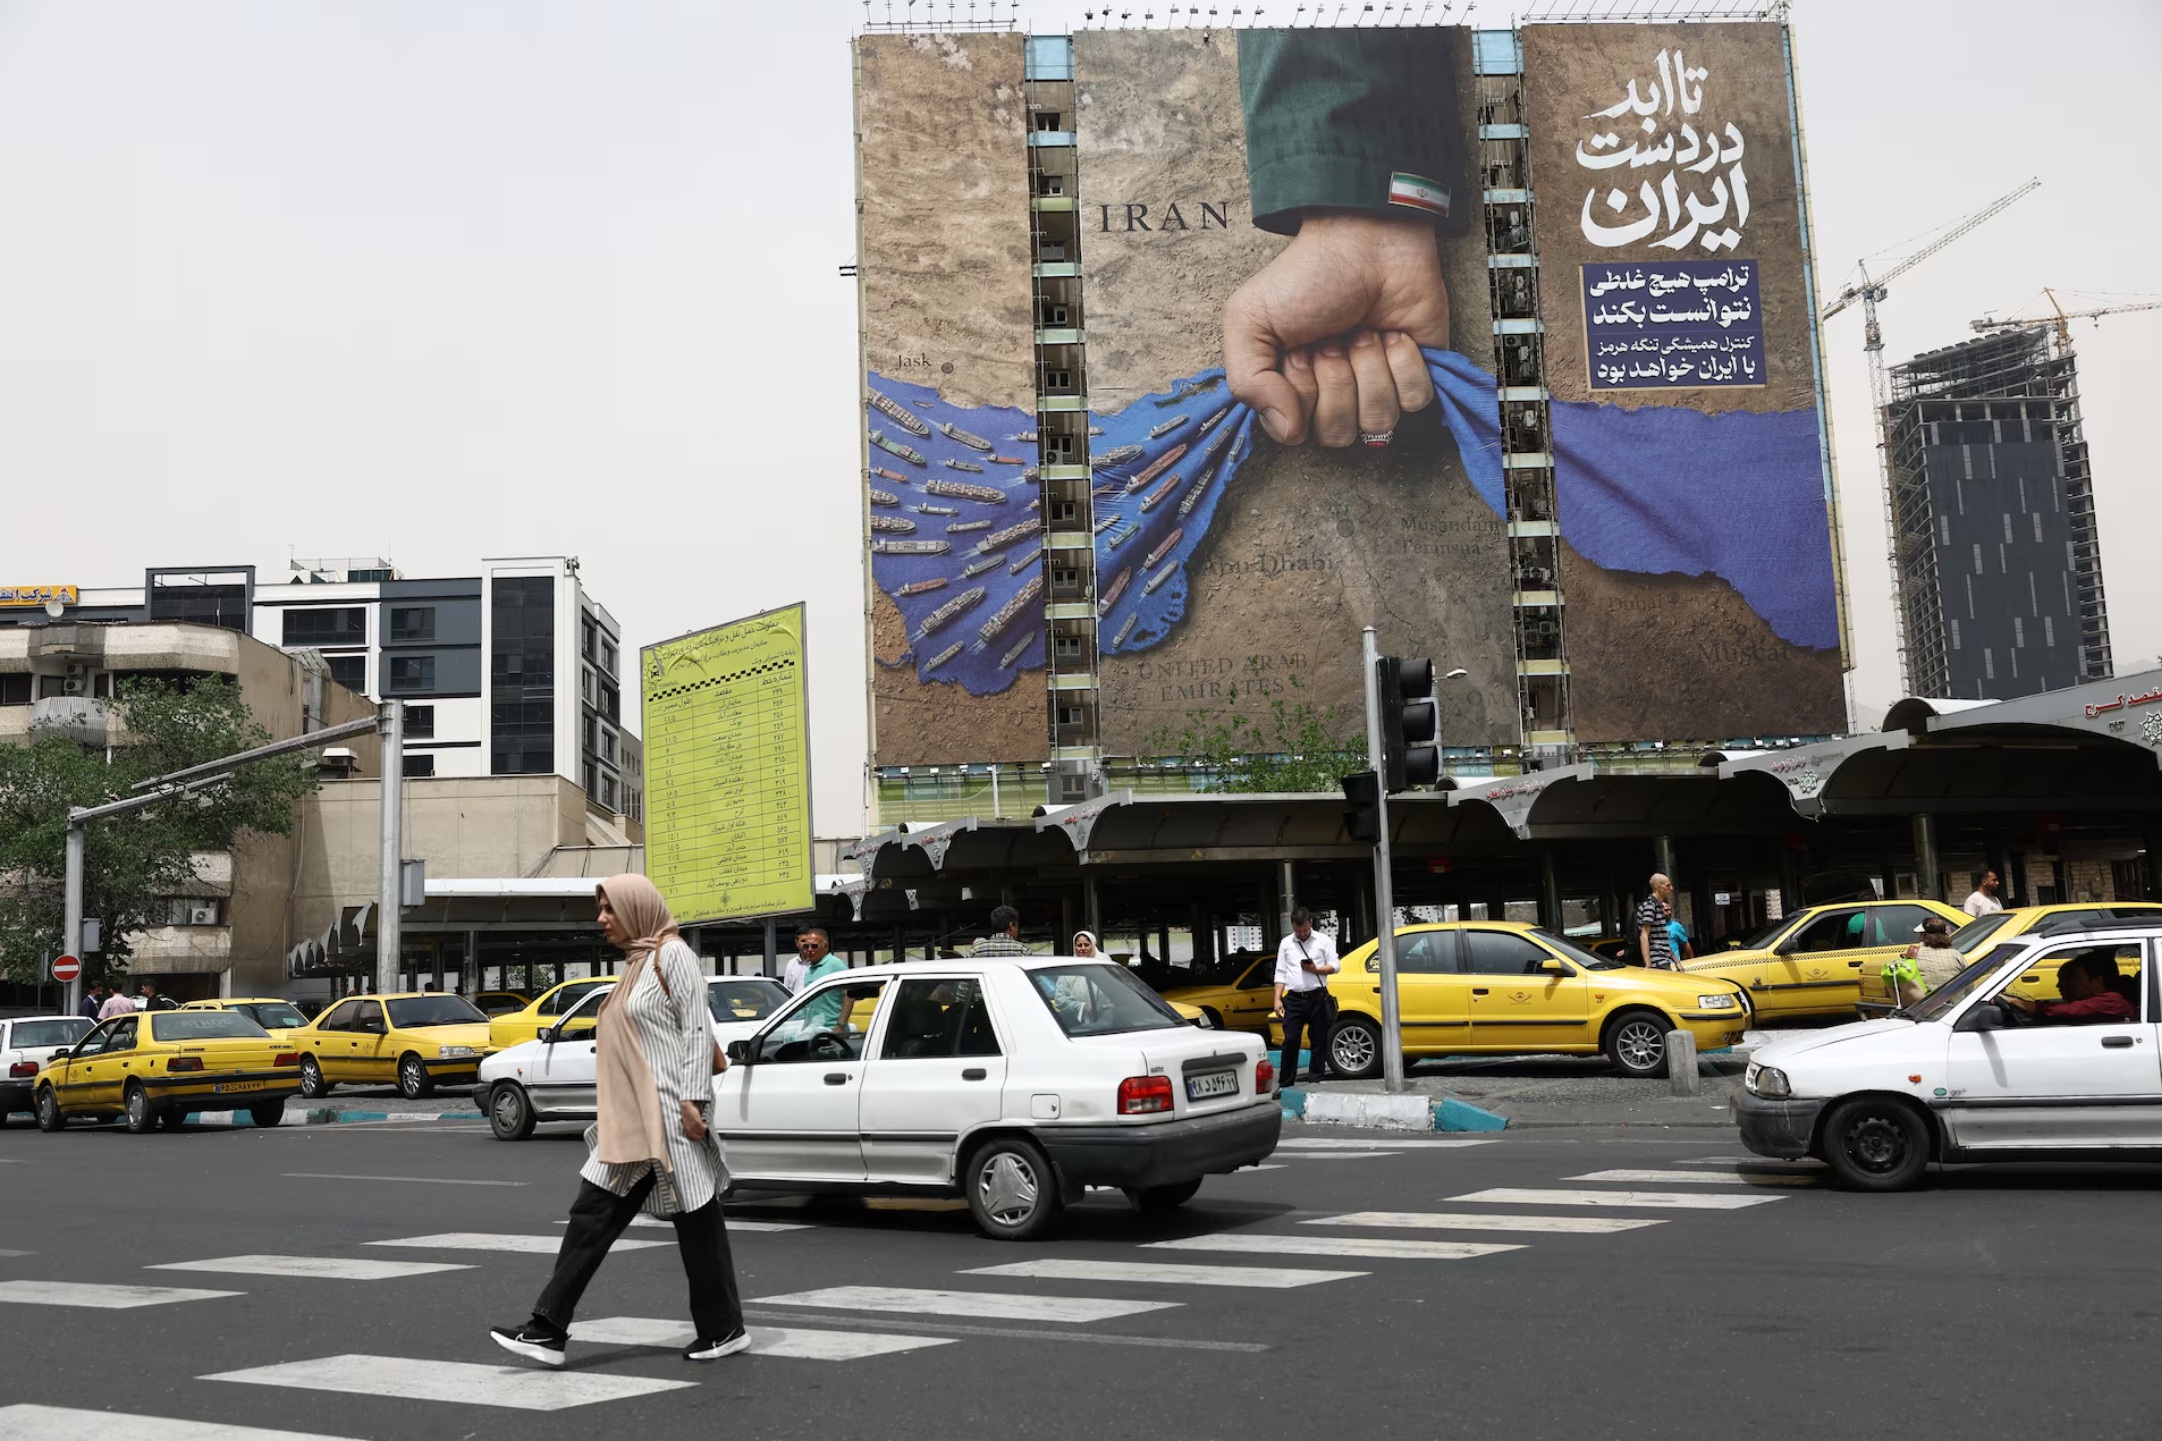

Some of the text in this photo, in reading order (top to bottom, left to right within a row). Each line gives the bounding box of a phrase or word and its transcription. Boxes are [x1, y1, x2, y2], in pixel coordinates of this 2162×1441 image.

[1581, 48, 1708, 122] تا ابد
[1576, 122, 1744, 174] در دست
[1100, 201, 1228, 232] IRAN
[1581, 161, 1750, 252] ایران
[1589, 266, 1749, 297] ترامپ هیچ غلطی
[1593, 296, 1752, 329] نتوانست بکند
[1596, 336, 1755, 356] کنترل همیشگی تنگه هرمز
[895, 352, 931, 370] Jask
[1597, 355, 1756, 384] با ایران خواهد بود
[21, 588, 52, 605] شرکت
[1697, 642, 1791, 664] Muscat
[774, 671, 793, 684] شماره
[1138, 657, 1233, 681] UNITED
[2084, 692, 2125, 717] کرج
